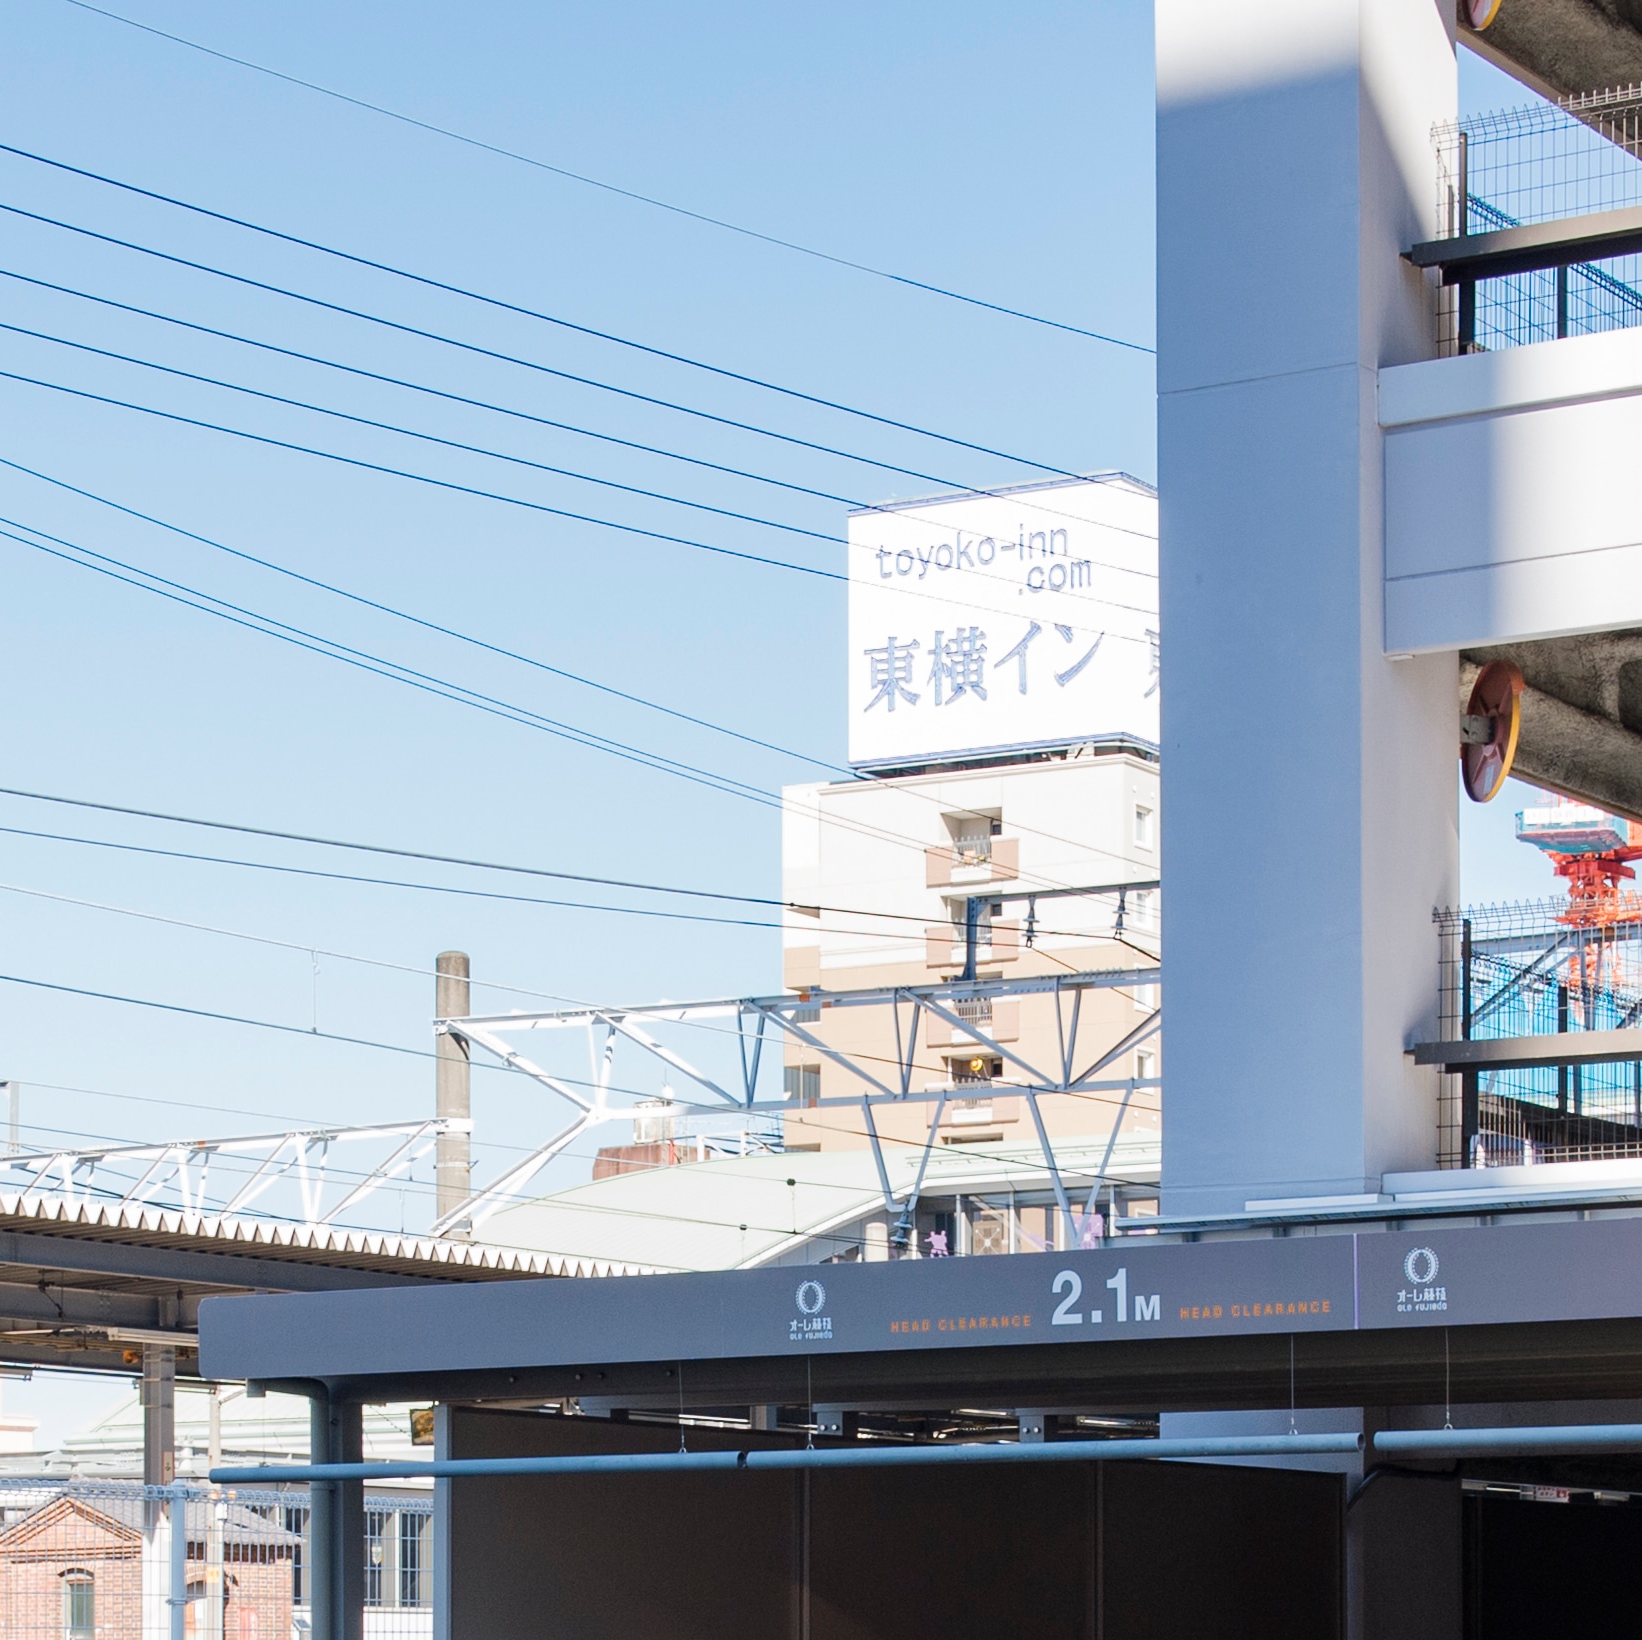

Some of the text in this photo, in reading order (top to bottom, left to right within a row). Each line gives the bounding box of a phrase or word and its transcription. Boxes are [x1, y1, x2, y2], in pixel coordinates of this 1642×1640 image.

[875, 522, 1069, 580] toyoko-inn
[863, 620, 1106, 713] 東横イン
[890, 1314, 1032, 1333] HEAD CLEARANCE
[1179, 1299, 1332, 1320] HEAD CLEARANCE
